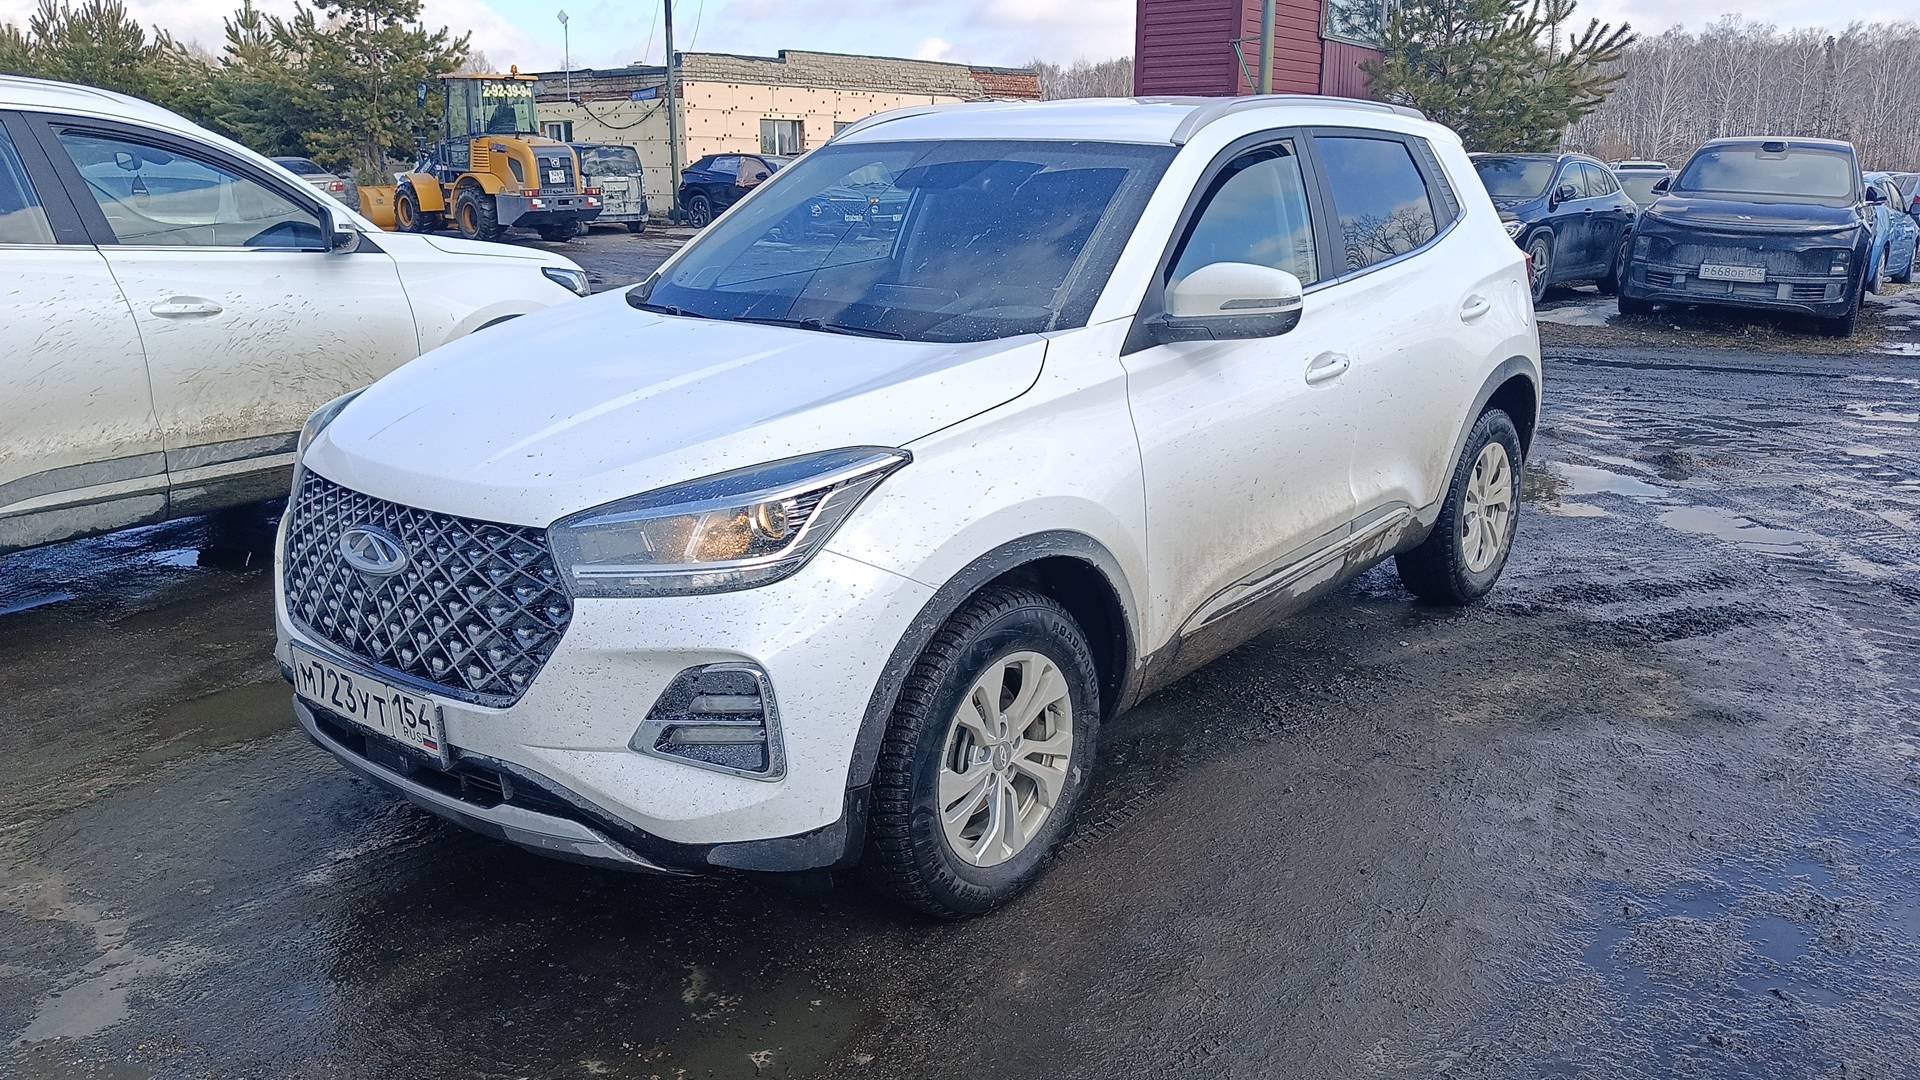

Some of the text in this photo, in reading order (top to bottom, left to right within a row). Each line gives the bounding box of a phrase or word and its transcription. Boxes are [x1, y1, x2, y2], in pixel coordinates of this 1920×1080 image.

[482, 84, 532, 98] 2-92-39-94
[1747, 268, 1764, 277] 154
[299, 660, 433, 736] М723УТ 154
[403, 727, 424, 744] RUS
